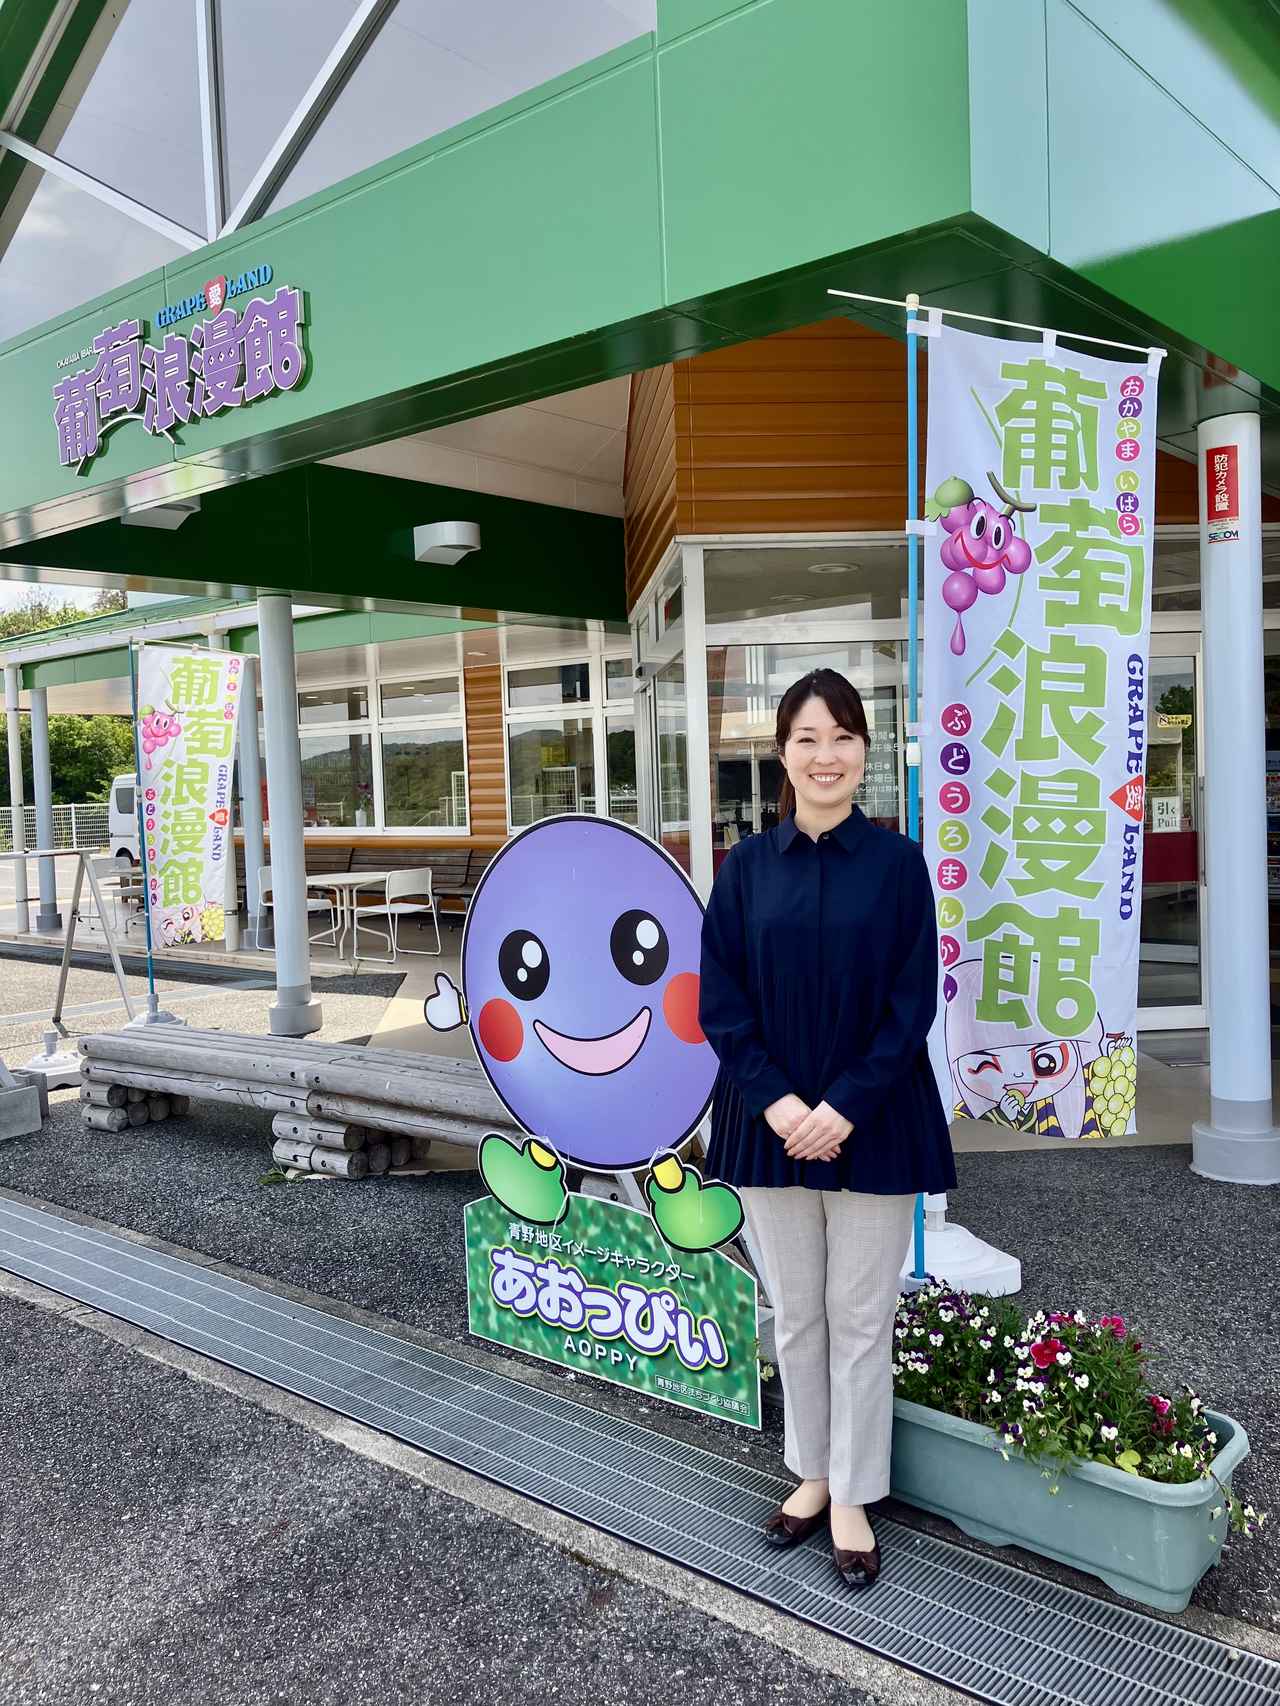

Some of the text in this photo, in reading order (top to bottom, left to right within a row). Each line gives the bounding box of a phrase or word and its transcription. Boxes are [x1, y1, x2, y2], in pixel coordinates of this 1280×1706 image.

[154, 290, 208, 328] GRAPE
[226, 264, 274, 299] LAND
[52, 285, 305, 465] 葡萄浪漫館
[1116, 377, 1143, 535] おかやま いばら
[1214, 454, 1230, 512] 防犯カメラ設置
[1208, 530, 1239, 541] SECOM
[966, 358, 1145, 1037] 葡萄浪漫館
[1125, 653, 1145, 774] GRAPE
[159, 655, 233, 908] 葡萄浪漫館
[216, 763, 229, 807] GRAPE
[1157, 801, 1176, 816] 引く
[212, 826, 224, 861] LAND
[939, 707, 970, 1000] ぶどうろまんか
[1119, 823, 1142, 921] LAND
[508, 1222, 696, 1281] 青野地区イメージキャラクター
[490, 1246, 727, 1370] あおっぴい
[564, 1335, 639, 1371] AOPPY
